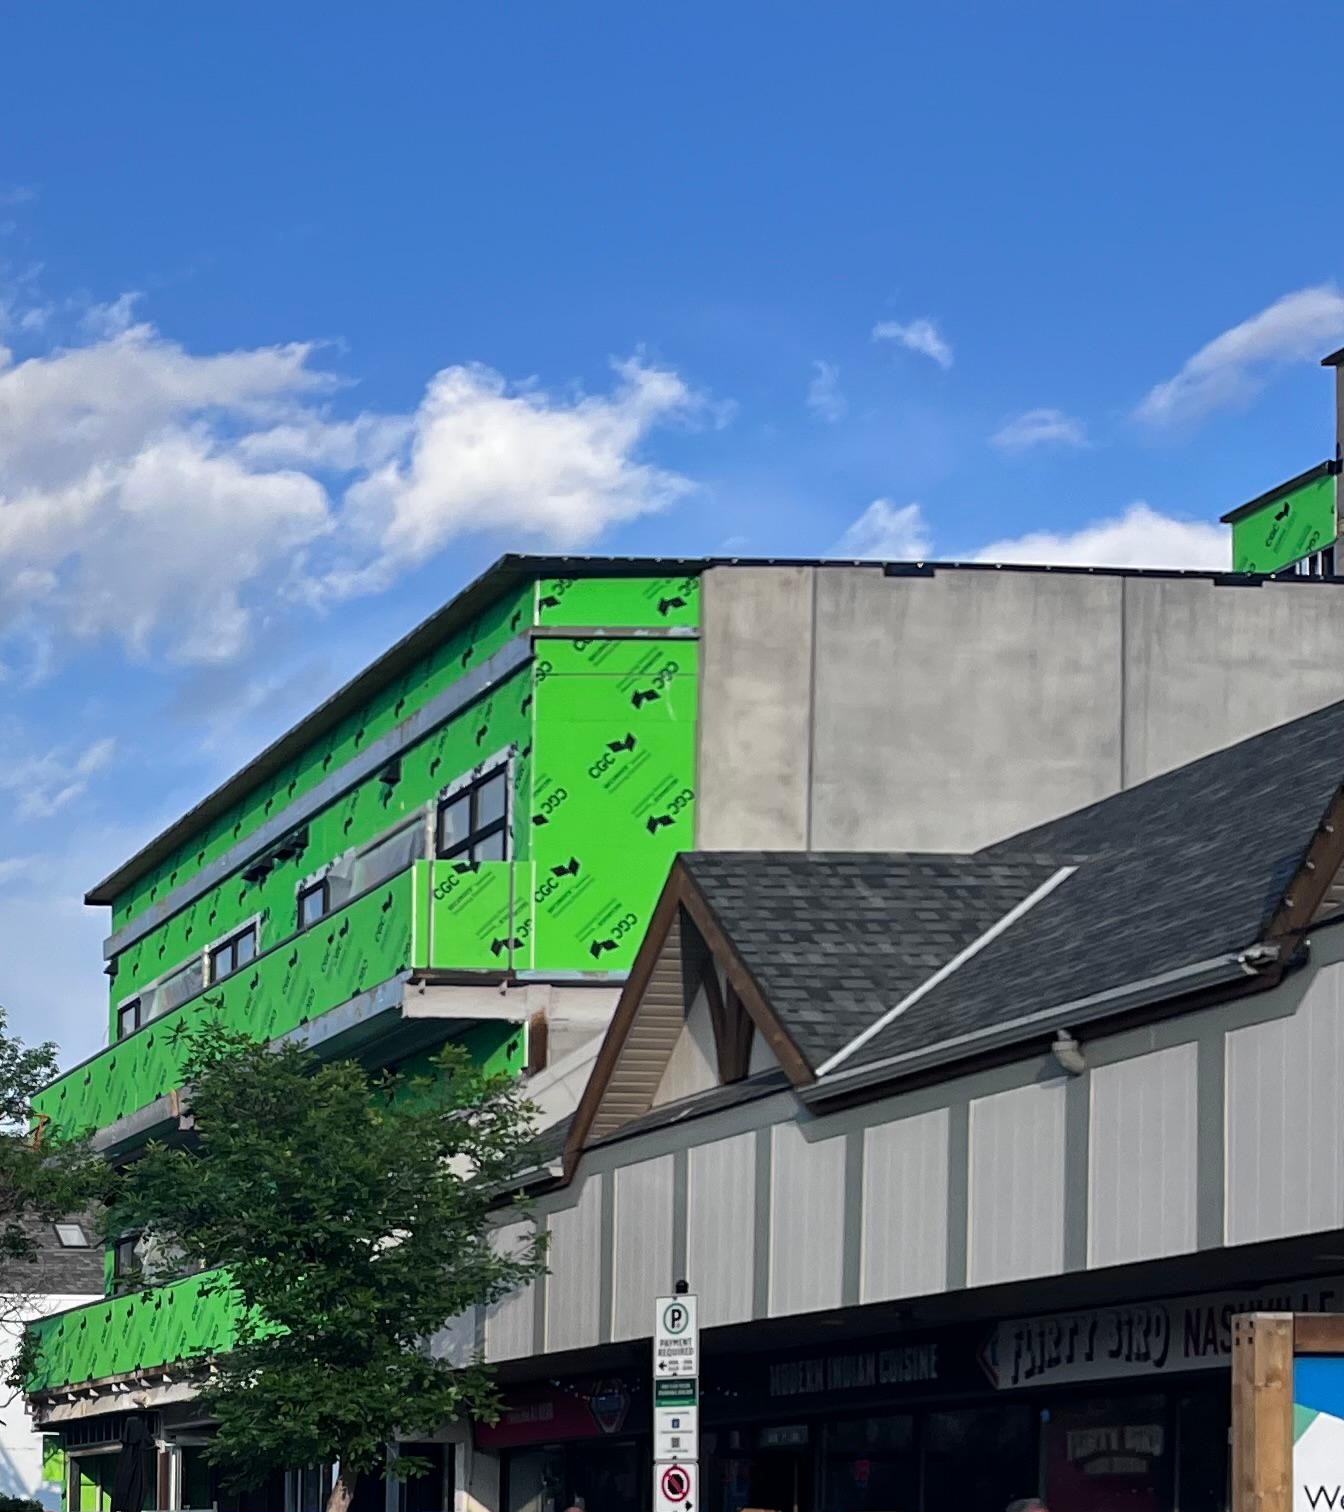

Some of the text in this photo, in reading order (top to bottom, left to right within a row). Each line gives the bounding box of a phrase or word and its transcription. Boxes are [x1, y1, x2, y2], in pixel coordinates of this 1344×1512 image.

[588, 752, 616, 779] CGC
[541, 788, 568, 815] CGC
[667, 788, 695, 815] CGC
[433, 874, 461, 901] CGC
[534, 877, 560, 903] CGC
[611, 913, 638, 939] CGC
[671, 1309, 682, 1329] P
[659, 1338, 693, 1347] PAYMENT
[1105, 1302, 1171, 1368] BIRD
[657, 1348, 694, 1357] REQUIRED
